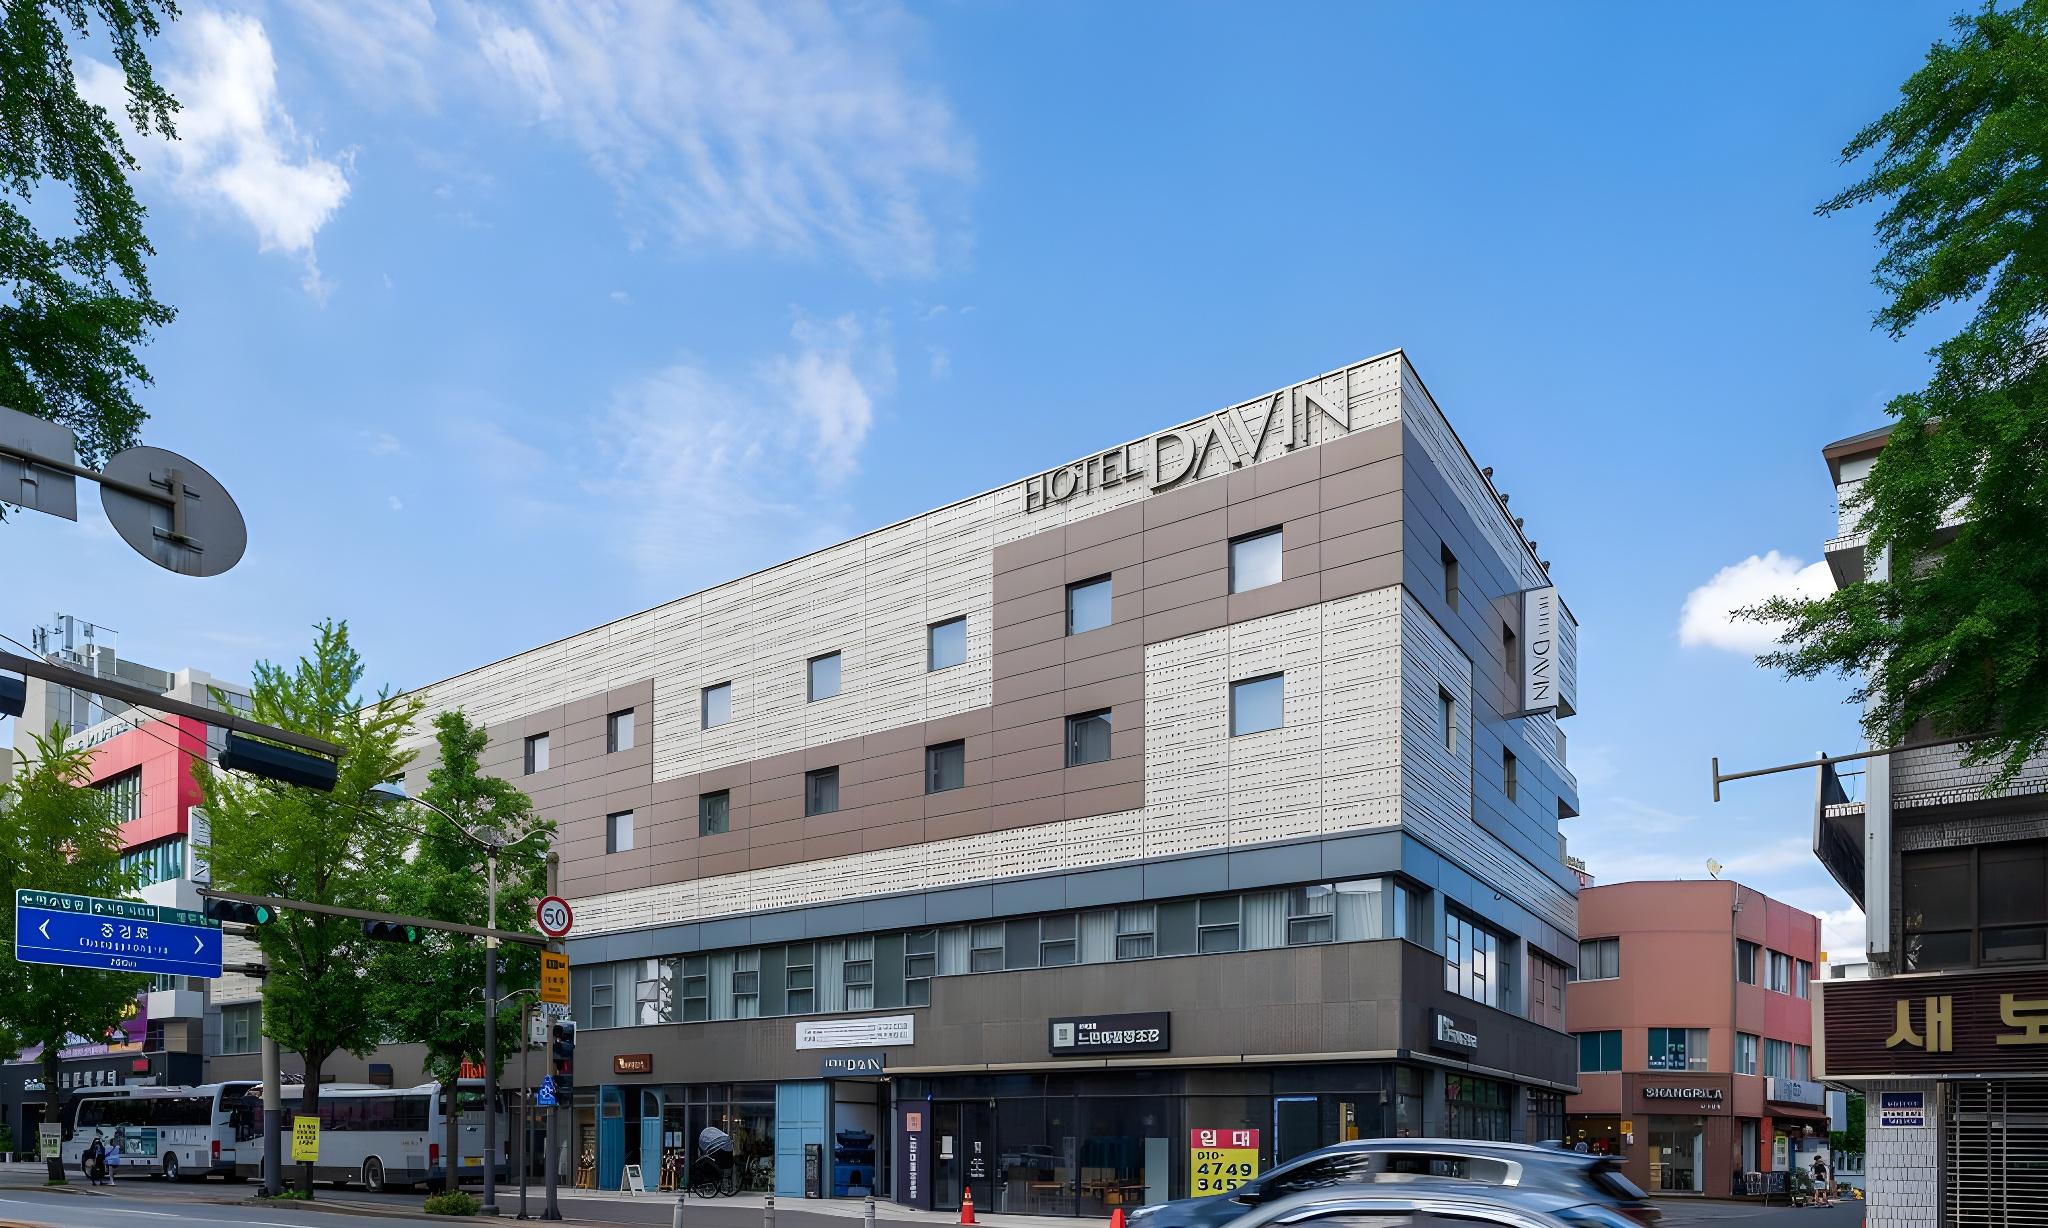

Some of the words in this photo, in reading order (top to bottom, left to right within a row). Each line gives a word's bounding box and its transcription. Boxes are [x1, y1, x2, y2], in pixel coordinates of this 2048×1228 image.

[1021, 444, 1147, 514] HOTEL
[1149, 368, 1350, 493] DAVIN
[1532, 639, 1550, 700] DAVIN
[544, 908, 565, 926] 50
[1197, 1162, 1252, 1176] 4749
[1197, 1178, 1252, 1191] 345
